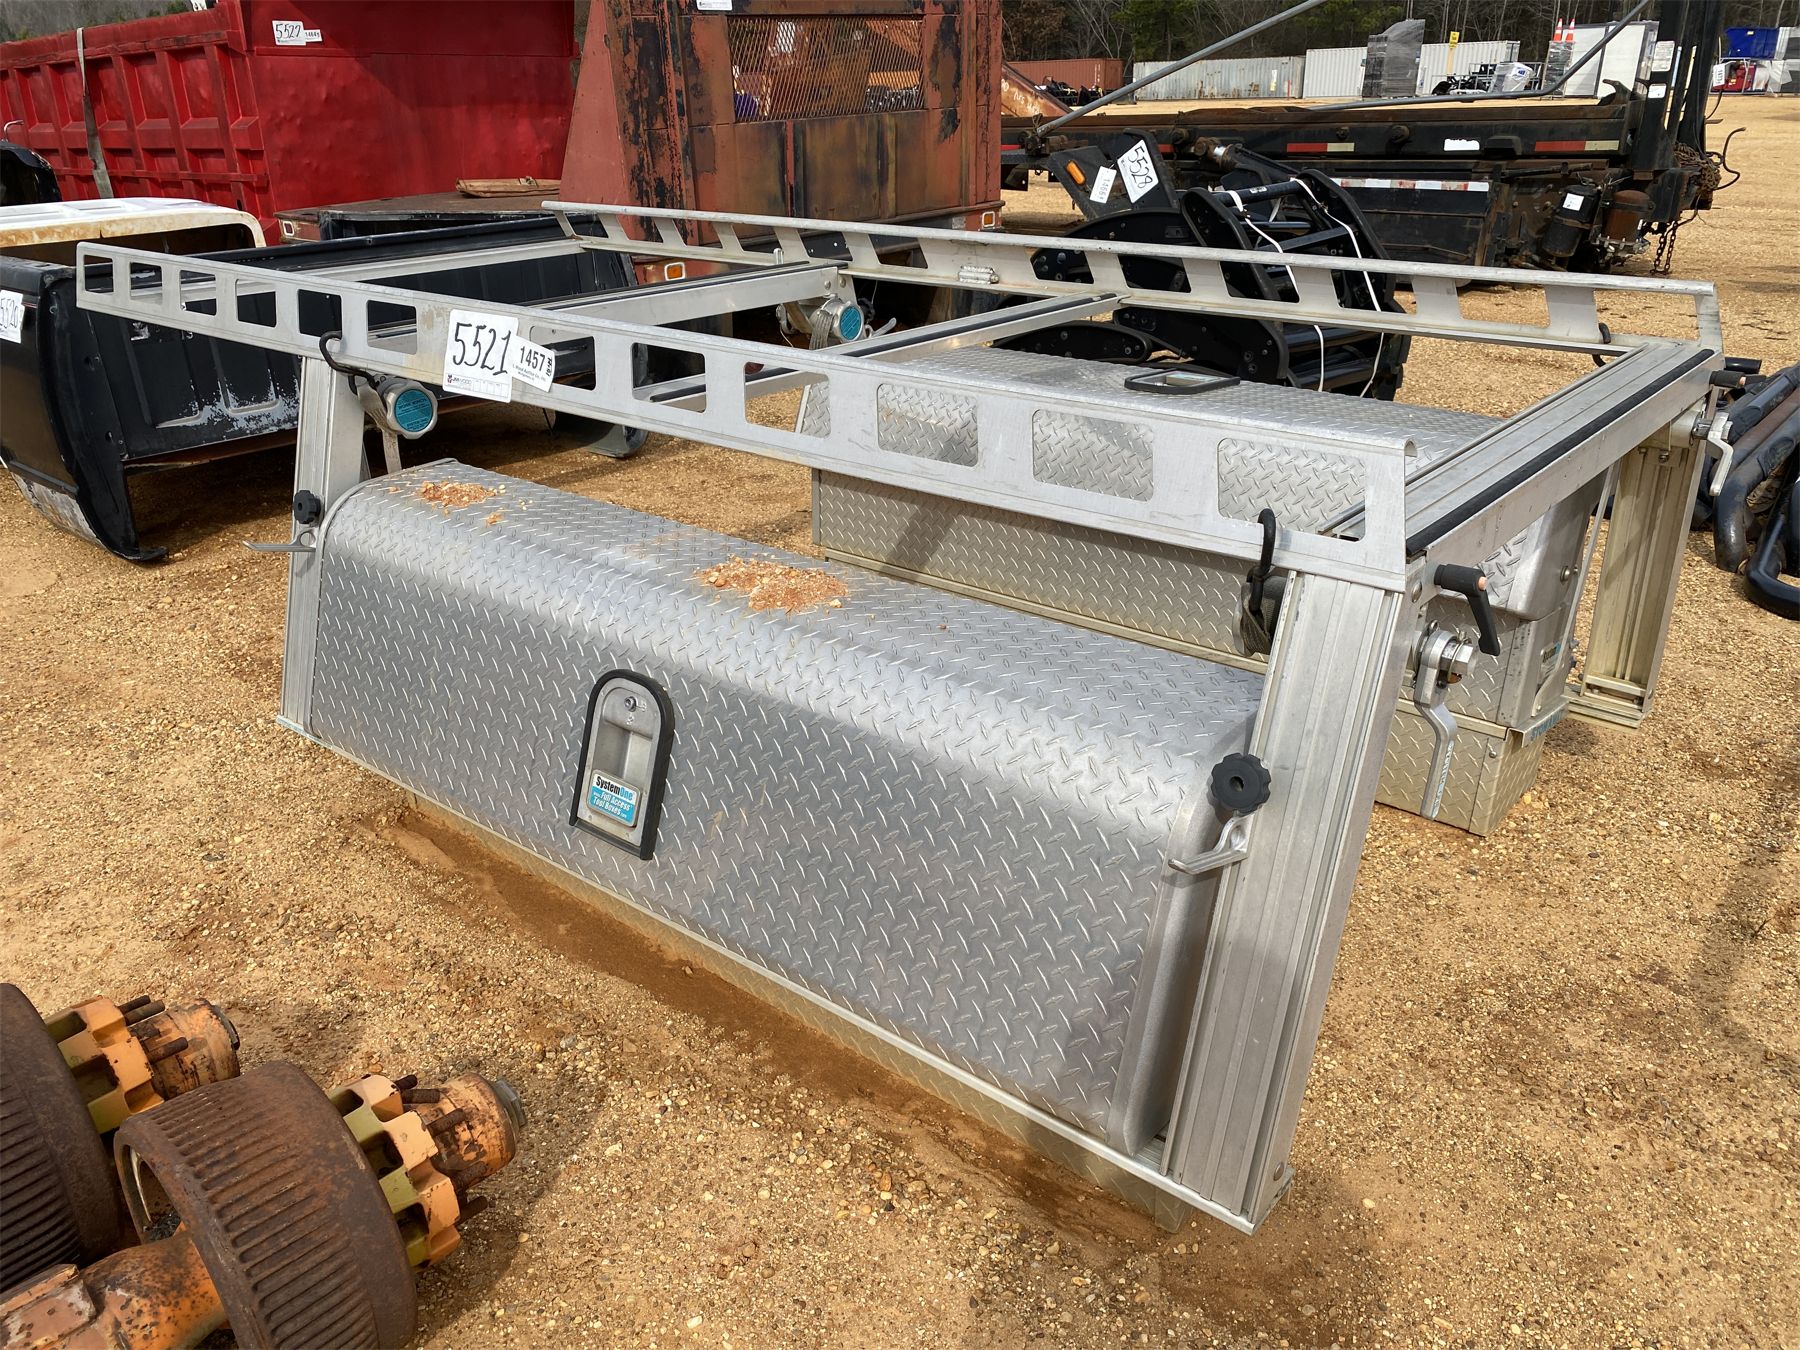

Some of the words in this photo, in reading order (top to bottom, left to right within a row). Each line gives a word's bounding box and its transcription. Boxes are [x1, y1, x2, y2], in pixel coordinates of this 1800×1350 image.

[1128, 145, 1153, 188] 5528
[453, 322, 511, 375] 5521
[520, 346, 545, 371] 1457
[596, 776, 634, 800] SystemOne
[593, 796, 606, 808] Tool
[604, 802, 621, 815] Boxes
[601, 790, 611, 802] Full
[610, 796, 630, 811] Access
